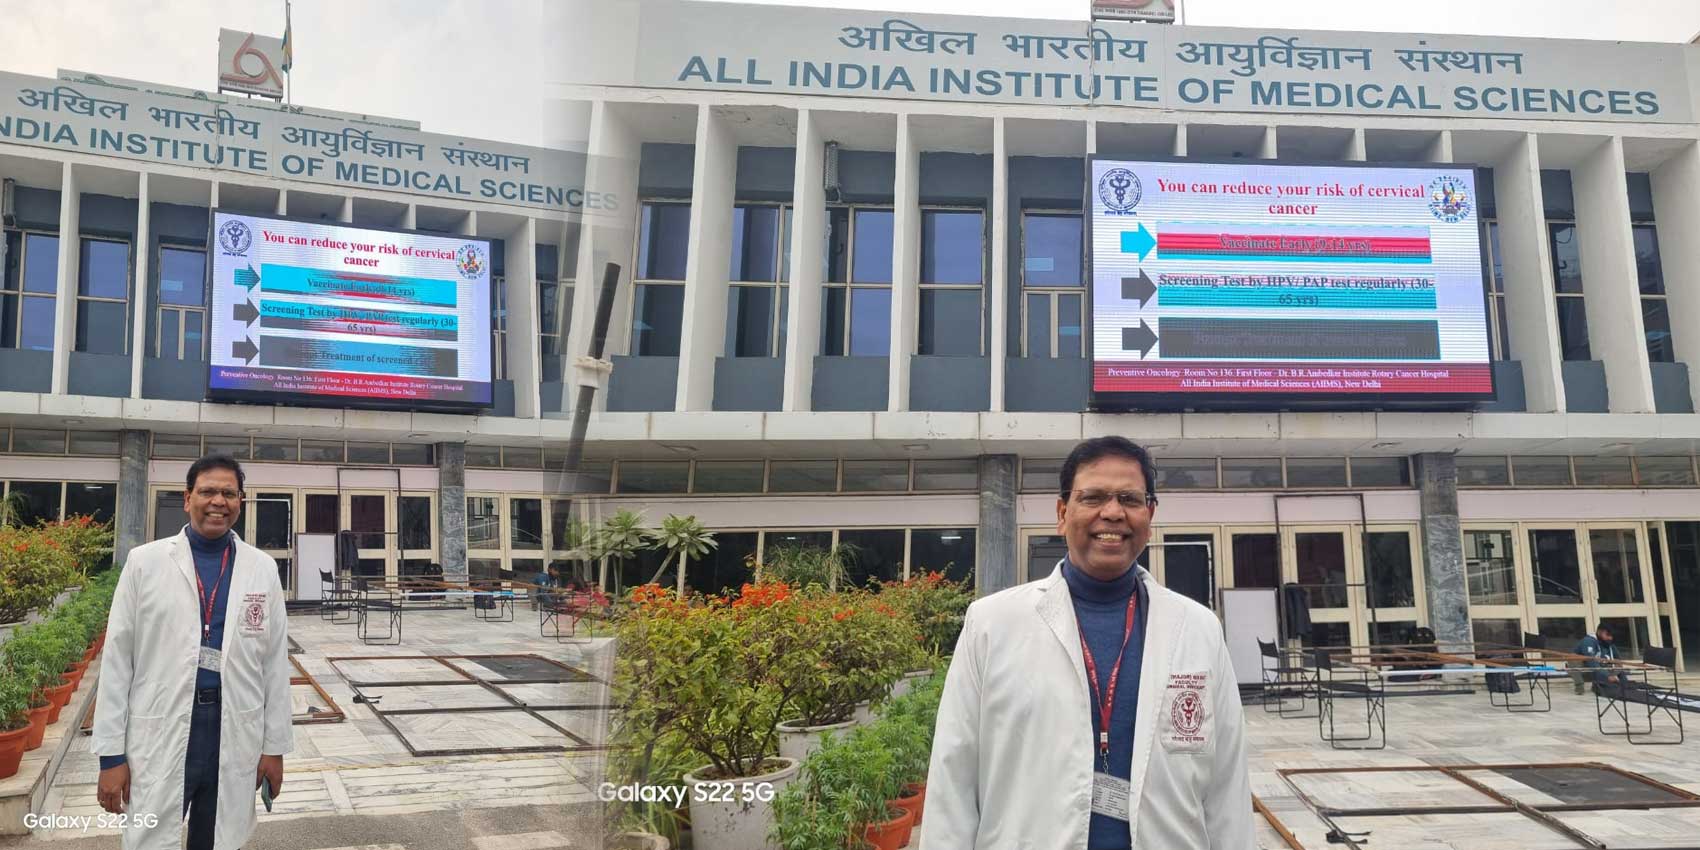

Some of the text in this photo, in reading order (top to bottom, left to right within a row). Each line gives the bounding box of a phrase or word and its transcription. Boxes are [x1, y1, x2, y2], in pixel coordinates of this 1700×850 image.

[837, 19, 1522, 77] अखिल भारतीय आयुर्विज्ञान संस्थान
[678, 55, 1660, 115] ALL INDIA INSTITUTE OF MEDICAL SCIENCES
[17, 86, 128, 121] अखिल
[149, 104, 260, 139] भारतीय
[281, 125, 424, 161] आयुर्विज्ञान
[441, 141, 530, 174] संस्थान
[0, 117, 619, 211] NDIA INSTITUTE OF MEDICAL SCIENCES
[1156, 178, 1425, 199] You can reduce your risk of cervical
[1268, 202, 1318, 216] cancer
[263, 231, 455, 260] You can reduce your risk of cervical
[1220, 236, 1277, 249] Vaccinate
[1279, 237, 1312, 251] Early
[1348, 240, 1371, 252] yrs)
[343, 253, 379, 268] cancer
[1159, 274, 1434, 291] Screening Test by HPV/ PAP test regularly (30-
[1279, 294, 1319, 307] 65 yrs)
[262, 303, 304, 316] Screening
[307, 307, 324, 316] Test
[326, 309, 337, 320] by
[401, 316, 439, 328] regularly
[441, 318, 457, 329] (30-
[348, 323, 376, 334] 65 yrs)
[321, 350, 364, 362] Treatment
[367, 353, 377, 363] of
[377, 355, 413, 366] screened
[1108, 368, 1145, 377] Preventive
[1147, 368, 1180, 378] Oncology
[1184, 369, 1206, 377] Room
[1207, 369, 1218, 377] No
[1236, 369, 1252, 377] First
[1254, 369, 1272, 377] Floor
[1372, 370, 1393, 379] Rotary
[1420, 370, 1448, 379] Hospital
[1280, 380, 1310, 388] Sciences
[1345, 380, 1360, 388] New
[1362, 380, 1381, 388] Delhi
